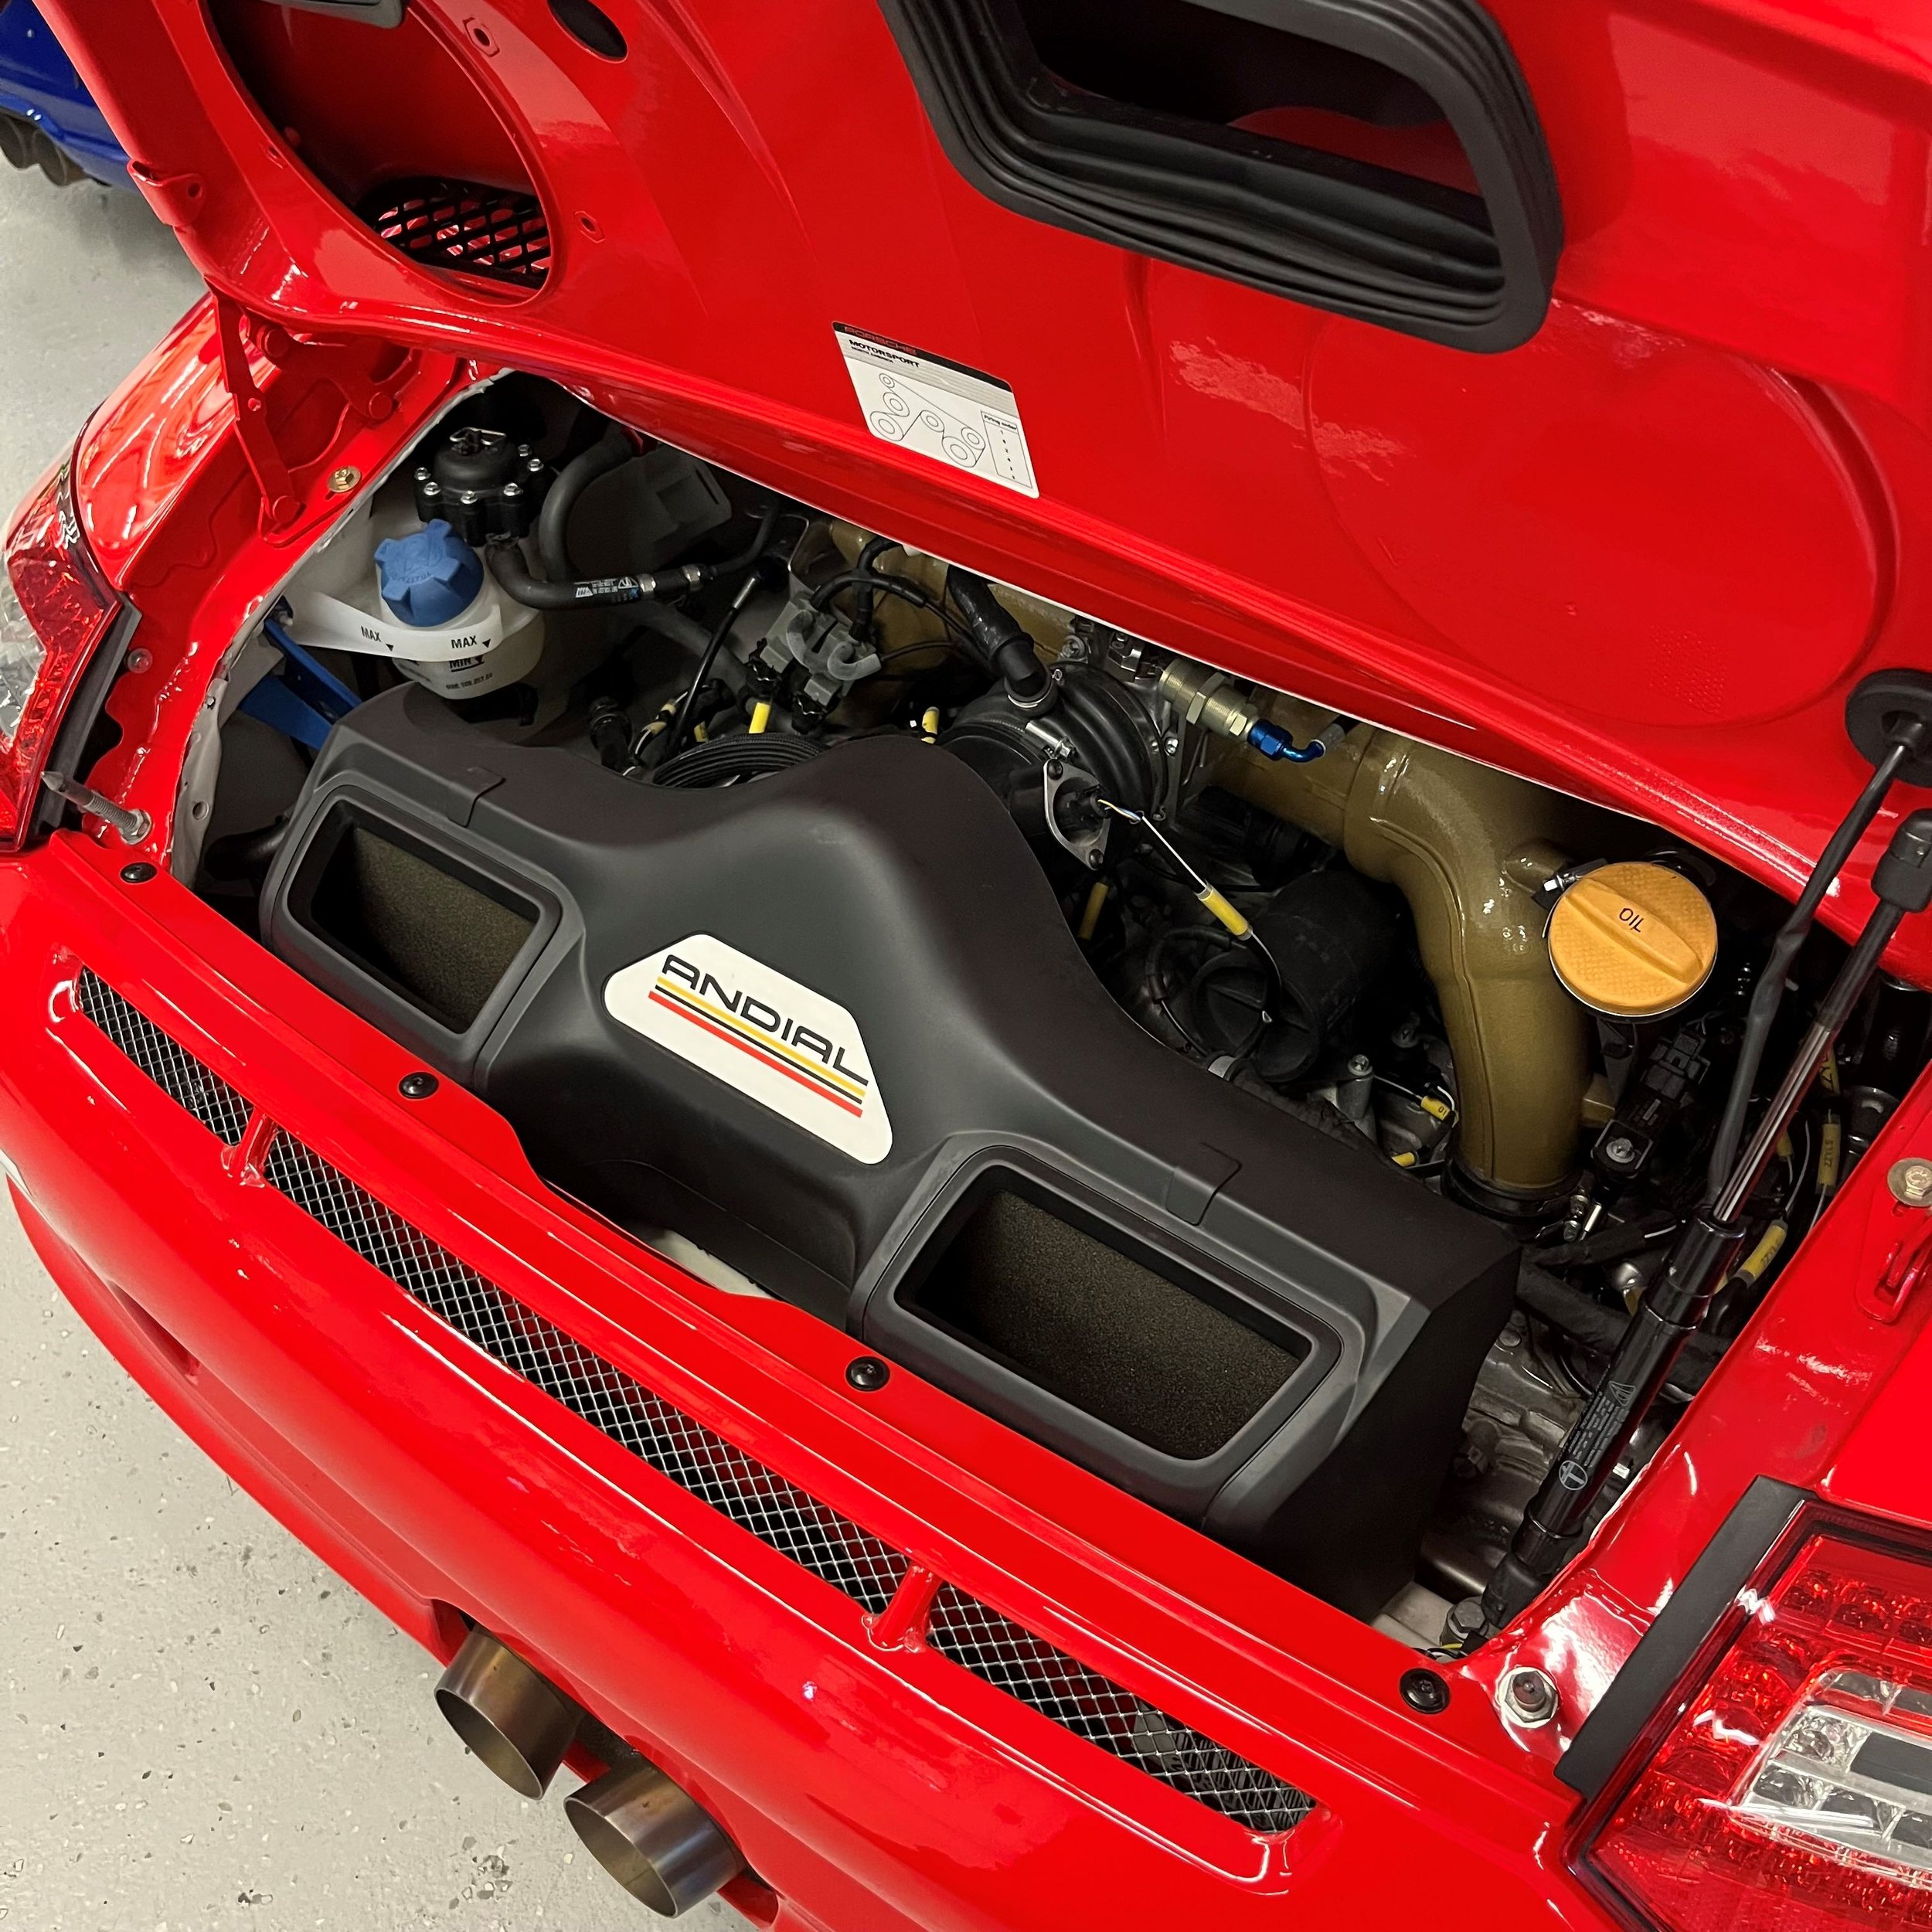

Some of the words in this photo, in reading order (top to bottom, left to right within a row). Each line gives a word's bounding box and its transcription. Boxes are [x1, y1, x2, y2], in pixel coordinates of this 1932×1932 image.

[844, 326, 917, 355] PORSCHE
[849, 339, 920, 368] MOTORSPORT
[361, 626, 382, 643] MAX
[451, 635, 478, 649] MAX
[449, 657, 471, 668] MIN
[1619, 907, 1644, 933] OIL
[662, 954, 869, 1087] ANDIAL
